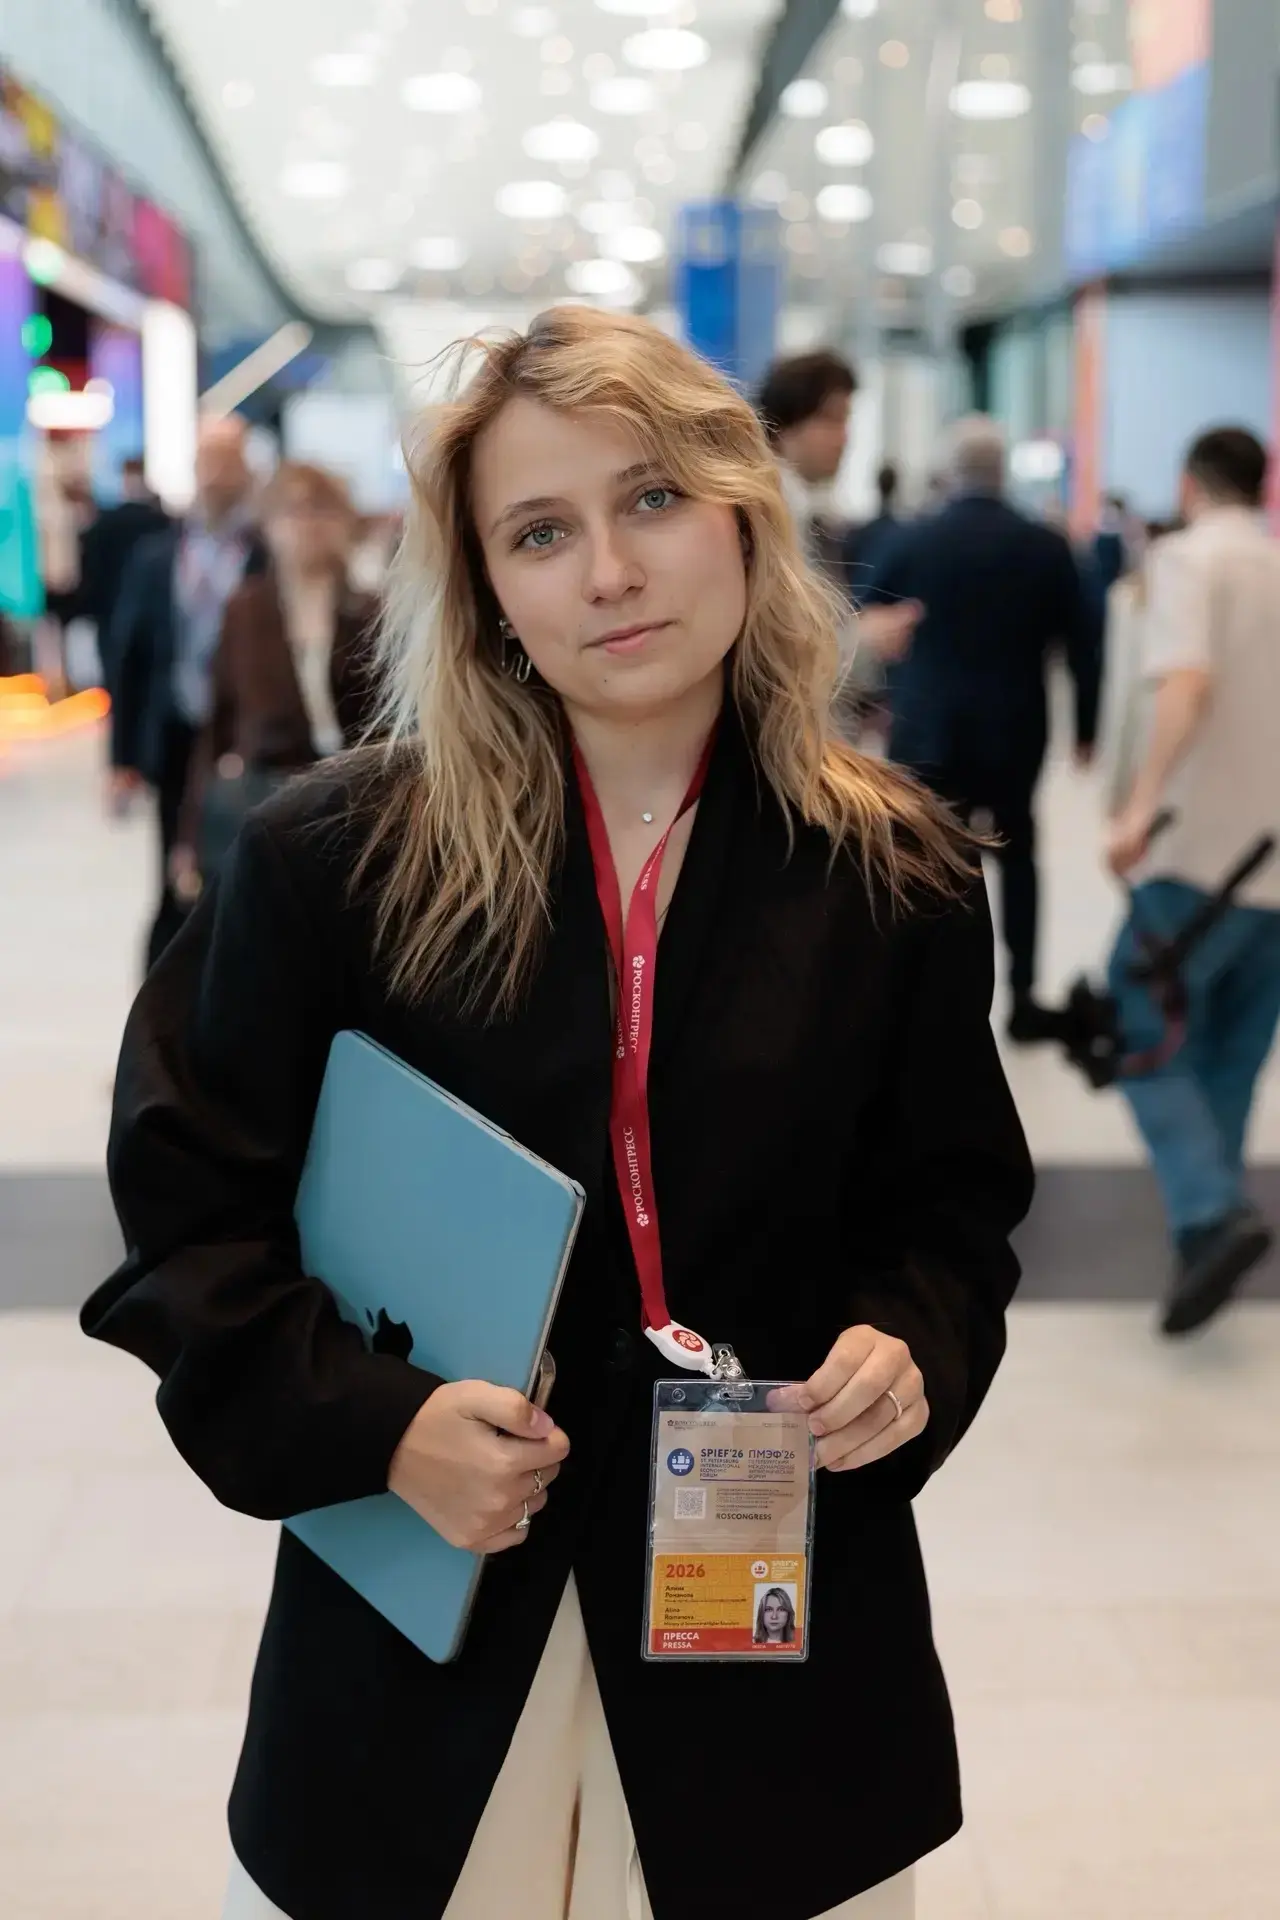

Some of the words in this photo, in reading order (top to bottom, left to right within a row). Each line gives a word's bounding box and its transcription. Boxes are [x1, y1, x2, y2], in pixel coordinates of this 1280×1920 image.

[623, 1126, 645, 1213] РОСКОНГРЕСС
[715, 1512, 772, 1521] ROSCONGRESS
[665, 1563, 706, 1578] 2026
[663, 1632, 700, 1641] ПРЕССА
[662, 1641, 693, 1649] PRESSA
